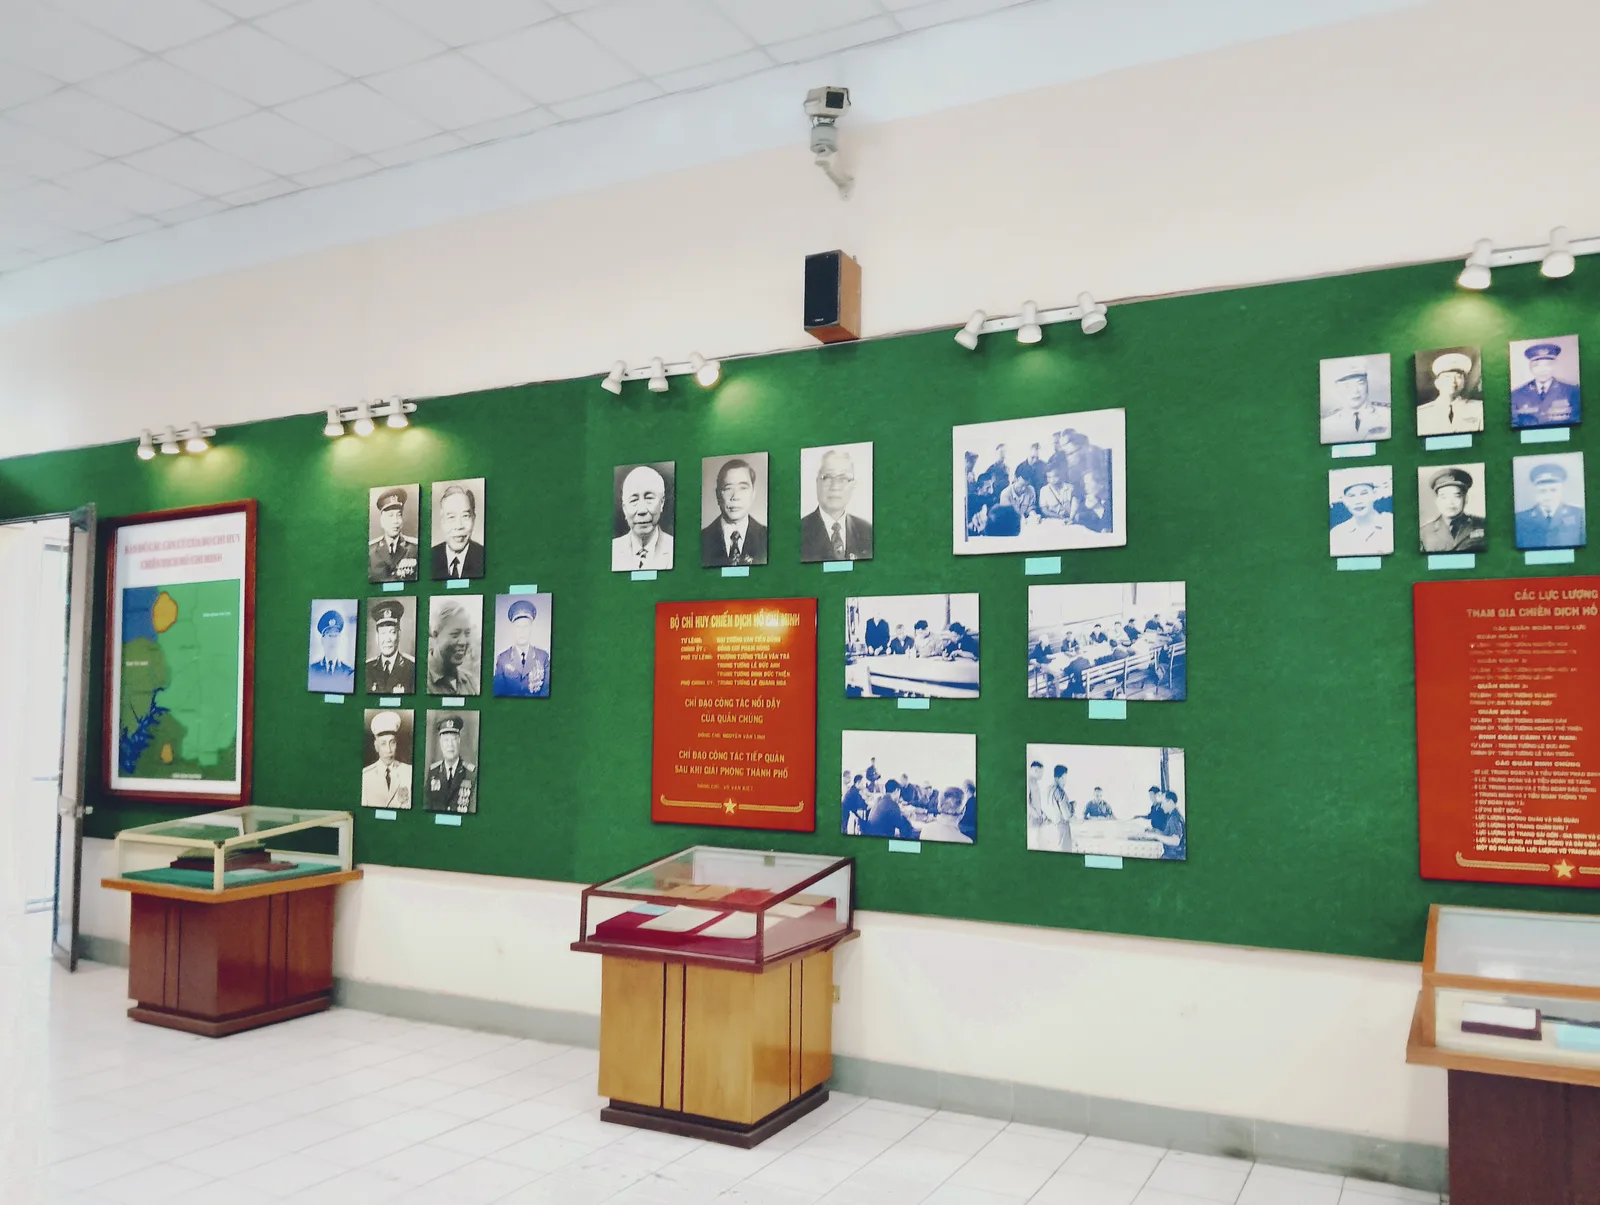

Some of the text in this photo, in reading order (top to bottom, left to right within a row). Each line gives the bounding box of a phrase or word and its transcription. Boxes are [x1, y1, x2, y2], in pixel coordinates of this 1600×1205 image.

[1514, 588, 1599, 602] CÁC LỰC LƯỢNG
[1466, 602, 1599, 618] THAM GIA CHIẾN DỊCH HỒ
[669, 612, 680, 631] BỘ
[681, 611, 694, 629] CHỈ
[695, 615, 710, 628] HUY
[710, 610, 733, 628] CHIẾN
[734, 613, 752, 630] DỊCH
[684, 696, 697, 708] CHỈ
[698, 698, 713, 709] ĐẠO
[714, 697, 734, 708] CÔNG
[735, 697, 750, 708] TÁC
[766, 697, 781, 710] DẬY
[701, 711, 764, 724] CỦA QUẦN CHÚNG
[679, 748, 785, 763] CHỈ ĐẠO CÔNG TÁC TIẾP QUẢN
[674, 763, 789, 779] SAU KHI GIẢI PHÓNG THÀNH PHỐ
